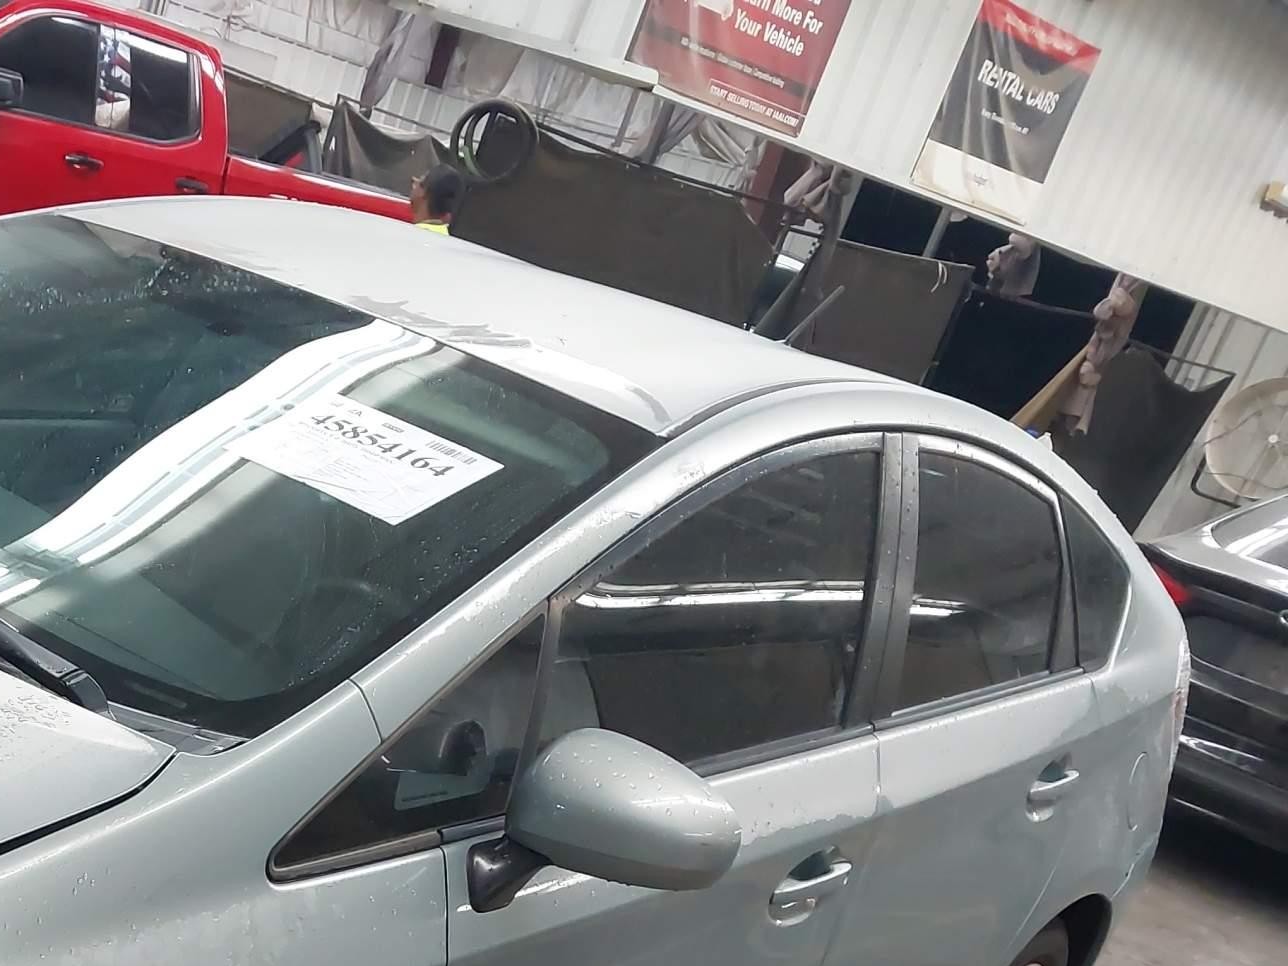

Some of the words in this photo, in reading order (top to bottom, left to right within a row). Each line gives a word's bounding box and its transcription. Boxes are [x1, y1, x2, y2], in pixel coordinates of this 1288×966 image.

[734, 8, 762, 37] Your
[764, 21, 804, 56] Vehicle
[772, 0, 803, 25] More
[802, 10, 824, 35] For
[977, 60, 1024, 101] RENTAL
[1026, 90, 1060, 114] CARS
[311, 415, 455, 477] 45854164
